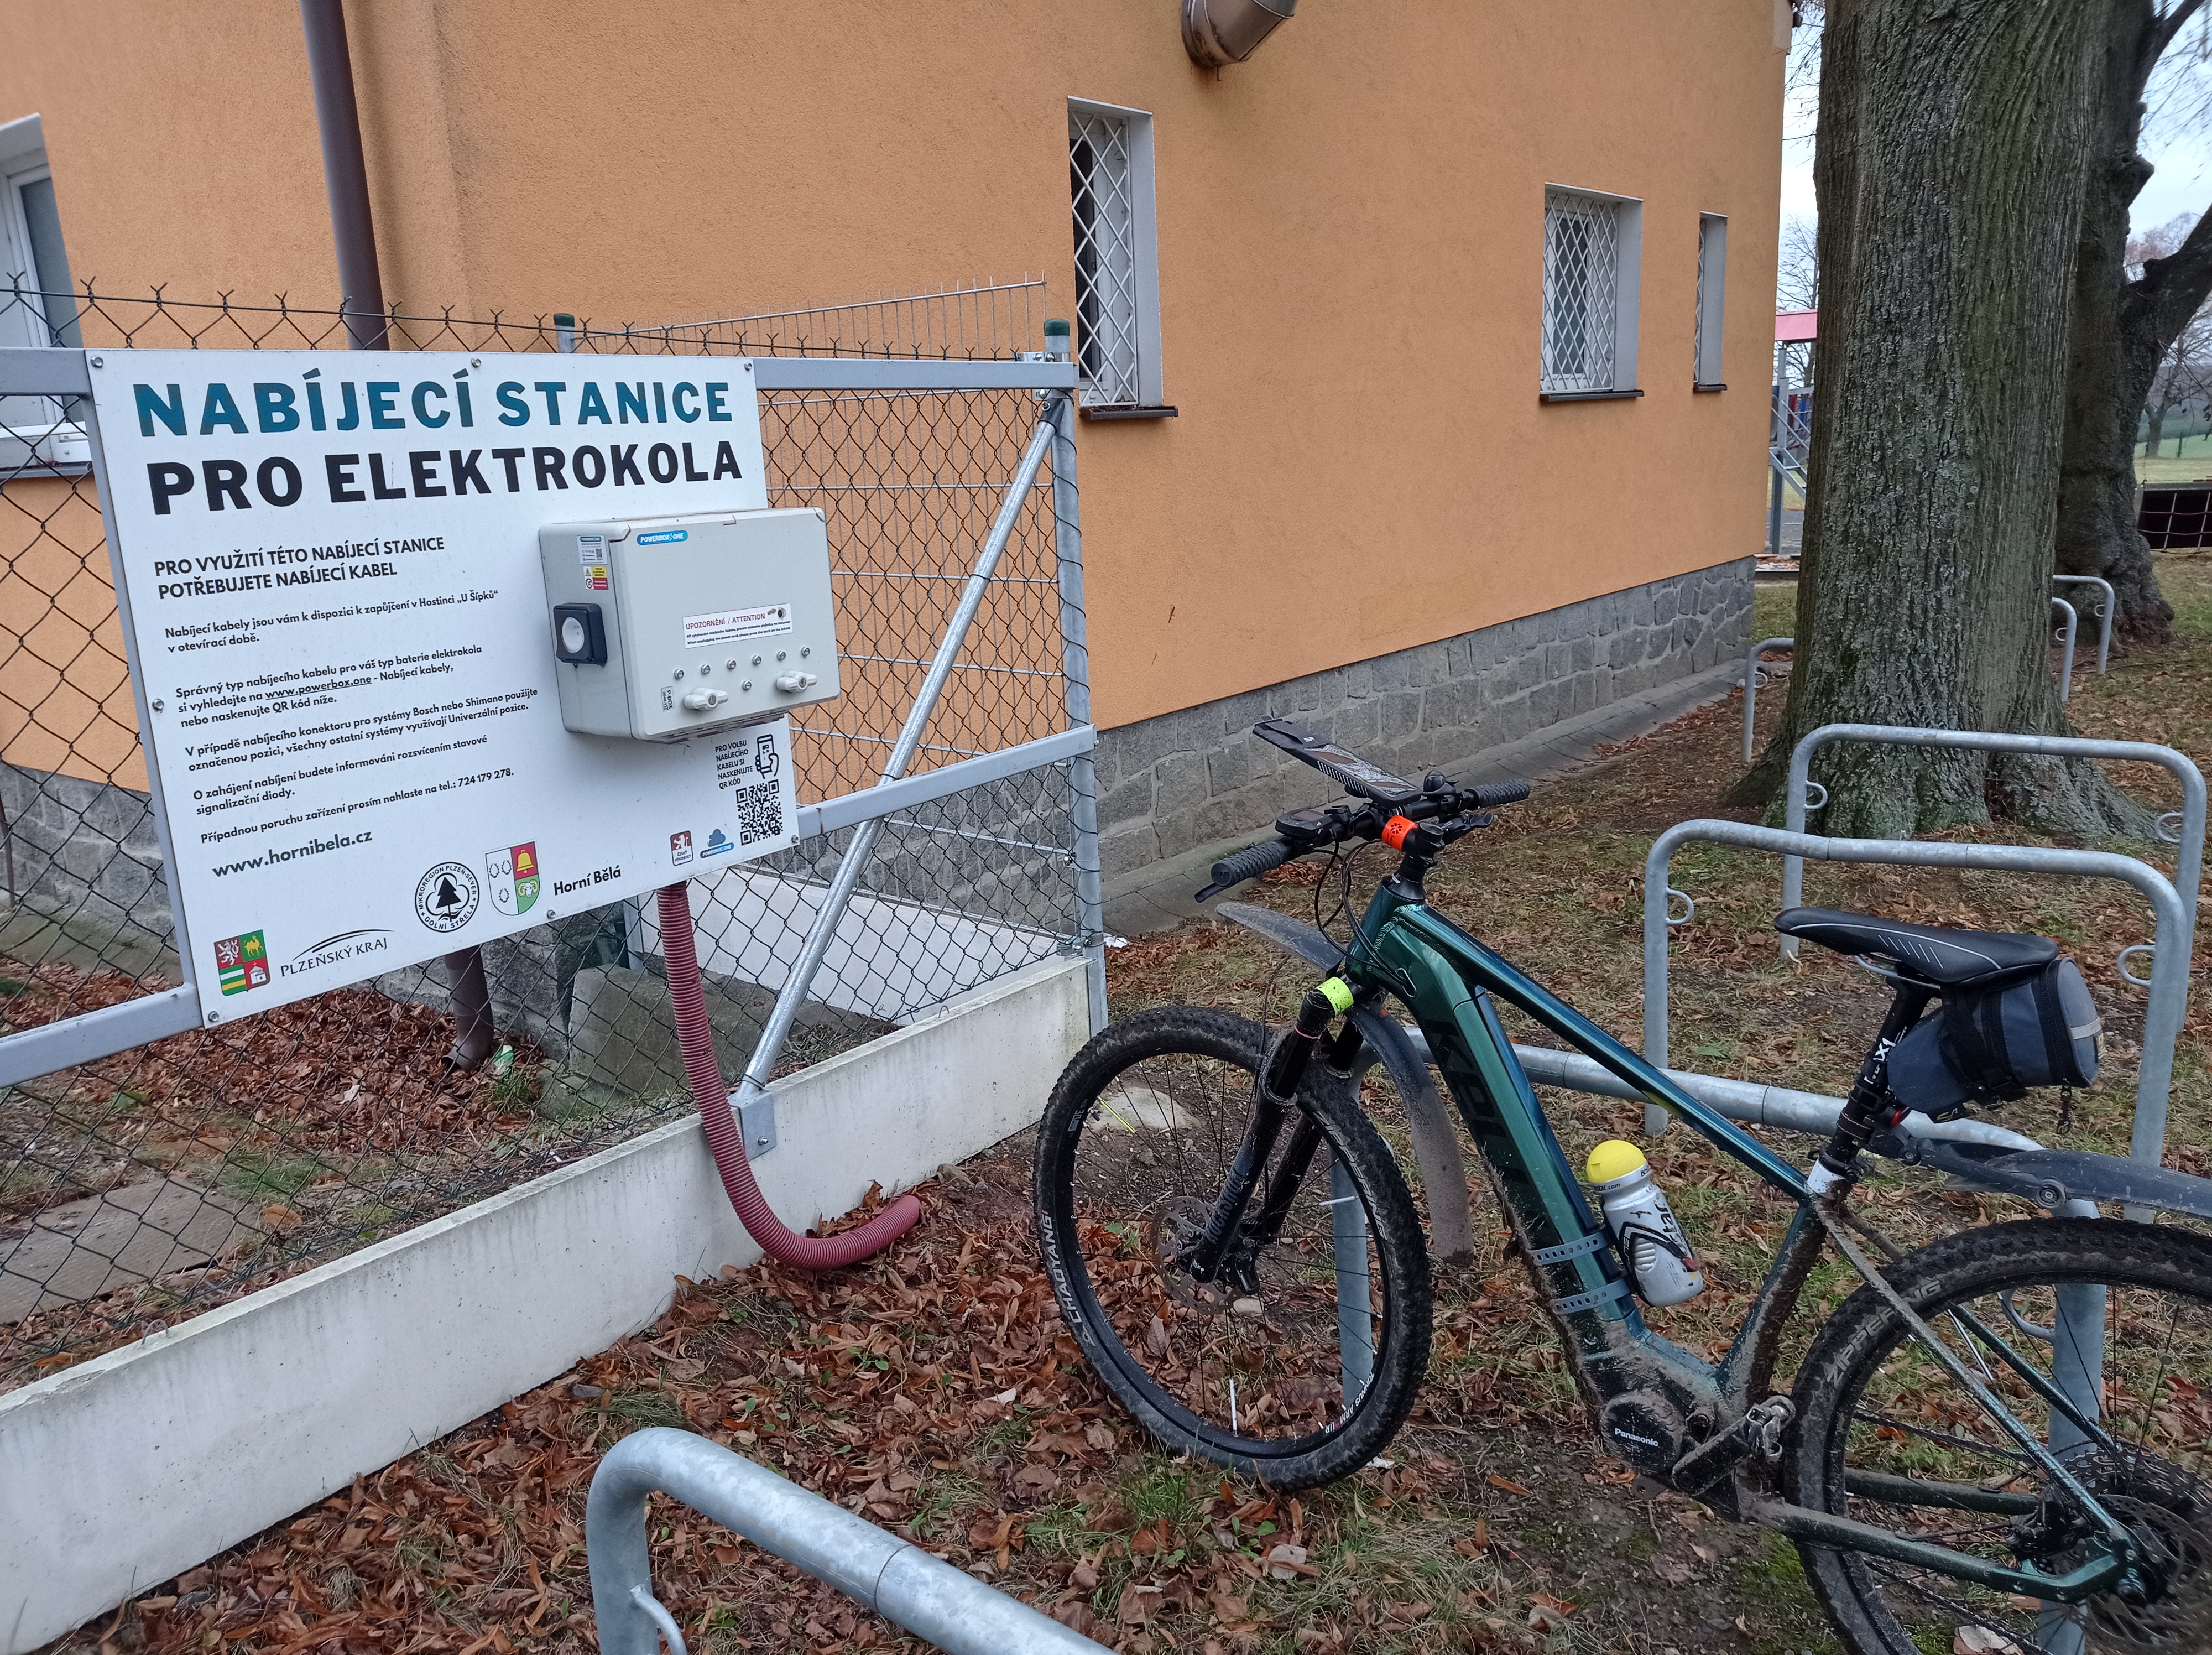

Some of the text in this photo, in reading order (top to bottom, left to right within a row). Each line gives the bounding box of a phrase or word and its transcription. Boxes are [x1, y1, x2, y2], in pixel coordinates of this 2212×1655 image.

[132, 367, 733, 438] NABÍJECÍ STANICE
[146, 440, 743, 516] PRO ELEKTROKOLA
[154, 537, 445, 576] PRO VYUŽITÍ TÉTO NABÍJECÍ STANICE
[158, 561, 398, 600] POTŘEBUJETE NABÍJECÍ KABEL
[165, 623, 211, 638] Nabíjecí
[212, 618, 251, 632] kabely
[252, 617, 274, 631] jsou
[275, 613, 300, 624] vám
[301, 611, 310, 621] k
[311, 606, 354, 621] dispozici
[355, 605, 363, 615] k
[364, 600, 410, 615] zapůjčení
[419, 594, 455, 607] Hostinci
[457, 593, 468, 604] „U
[469, 589, 498, 603] Šípků“
[686, 617, 725, 629] UPOZORNĚNÍ
[732, 613, 765, 623] ATTENTION
[178, 636, 227, 652] otevírací
[228, 632, 260, 645] době.
[175, 644, 482, 700] Správný typ nabíjecího kabelu pro váš typ baterie elektrokola
[178, 702, 187, 713] si
[189, 694, 247, 713] vyhledejte
[249, 693, 263, 701] na
[264, 676, 373, 701] www.powerbox.one
[379, 667, 418, 681] Nabíjecí
[419, 662, 453, 675] kabely,
[180, 694, 337, 728] nebo naskenujte QR kód níže.
[184, 688, 538, 758] V případě nabíjecího konektoru pro systémy Bosch nebo Shimano použijte
[188, 702, 529, 772] označenou pozici, všechny ostatní systémy využívají Univerzální pozice.
[714, 739, 747, 753] PRO VOLBU
[716, 748, 749, 762] NABÍJECÍHO
[193, 734, 487, 800] O zahájení nabíjení budete informováni rozsvícením stavové
[716, 759, 739, 771] KABELU
[717, 765, 753, 780] NASKENUJTE
[718, 777, 741, 790] QR KÓD
[196, 787, 295, 816] signalizační diody.
[200, 768, 514, 844] Případnou poruchu zařízení prosím nahlaste na tel.: 724 179 278.
[211, 831, 373, 877] www.hornibela.cz
[418, 866, 444, 910] MIKROREGION
[554, 865, 622, 896] Horní Bělá
[424, 904, 475, 930] DOLNÍ STŘELA
[280, 937, 387, 977] PLZEŇSKÝ KRAJ
[1041, 1212, 1082, 1324] CHAOYANG
[1614, 1427, 1659, 1447] Panasonic
